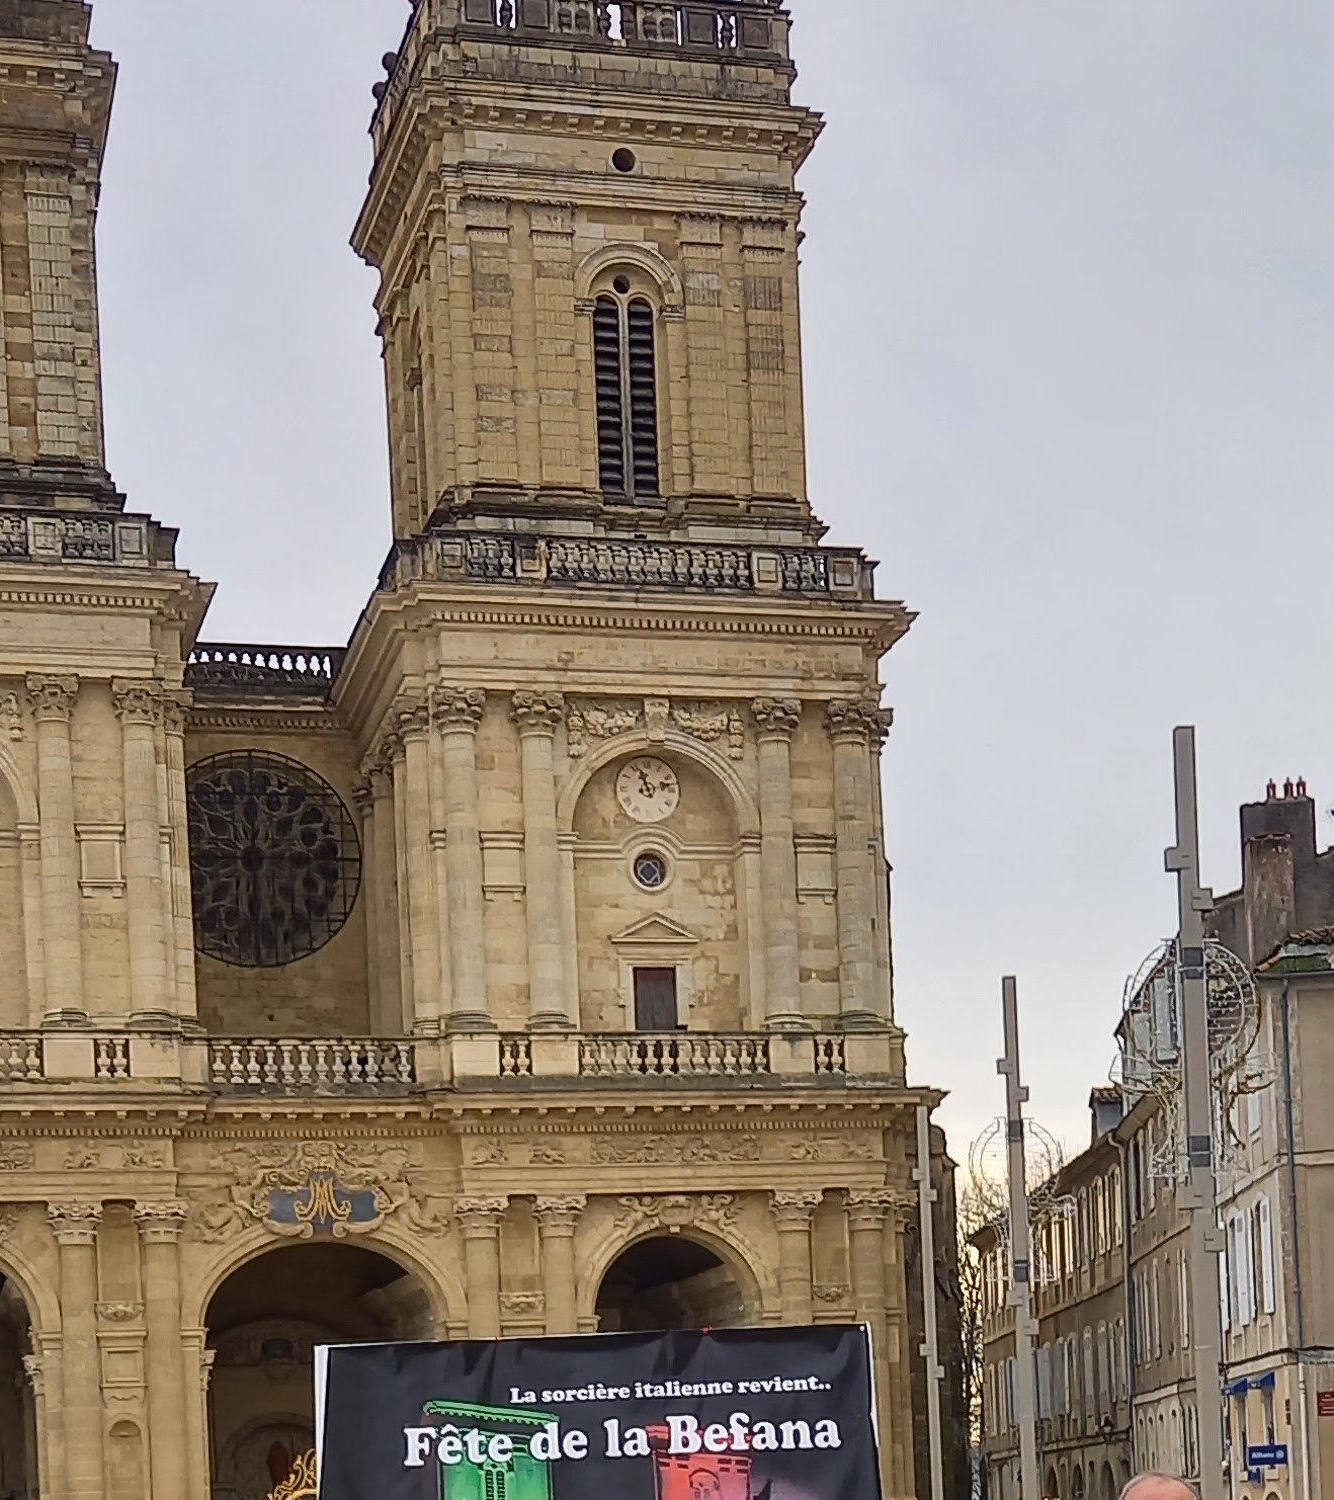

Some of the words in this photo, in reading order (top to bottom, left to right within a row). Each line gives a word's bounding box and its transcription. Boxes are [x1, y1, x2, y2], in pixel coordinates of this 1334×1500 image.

[509, 1387, 537, 1404] La
[541, 1383, 630, 1403] sorcière
[635, 1380, 733, 1399] italienne
[737, 1376, 832, 1393] revient..
[402, 1423, 514, 1467] Fête
[530, 1422, 588, 1461] de
[603, 1418, 651, 1457] la
[665, 1411, 842, 1455] Befana
[1251, 1451, 1275, 1459] Allianz
